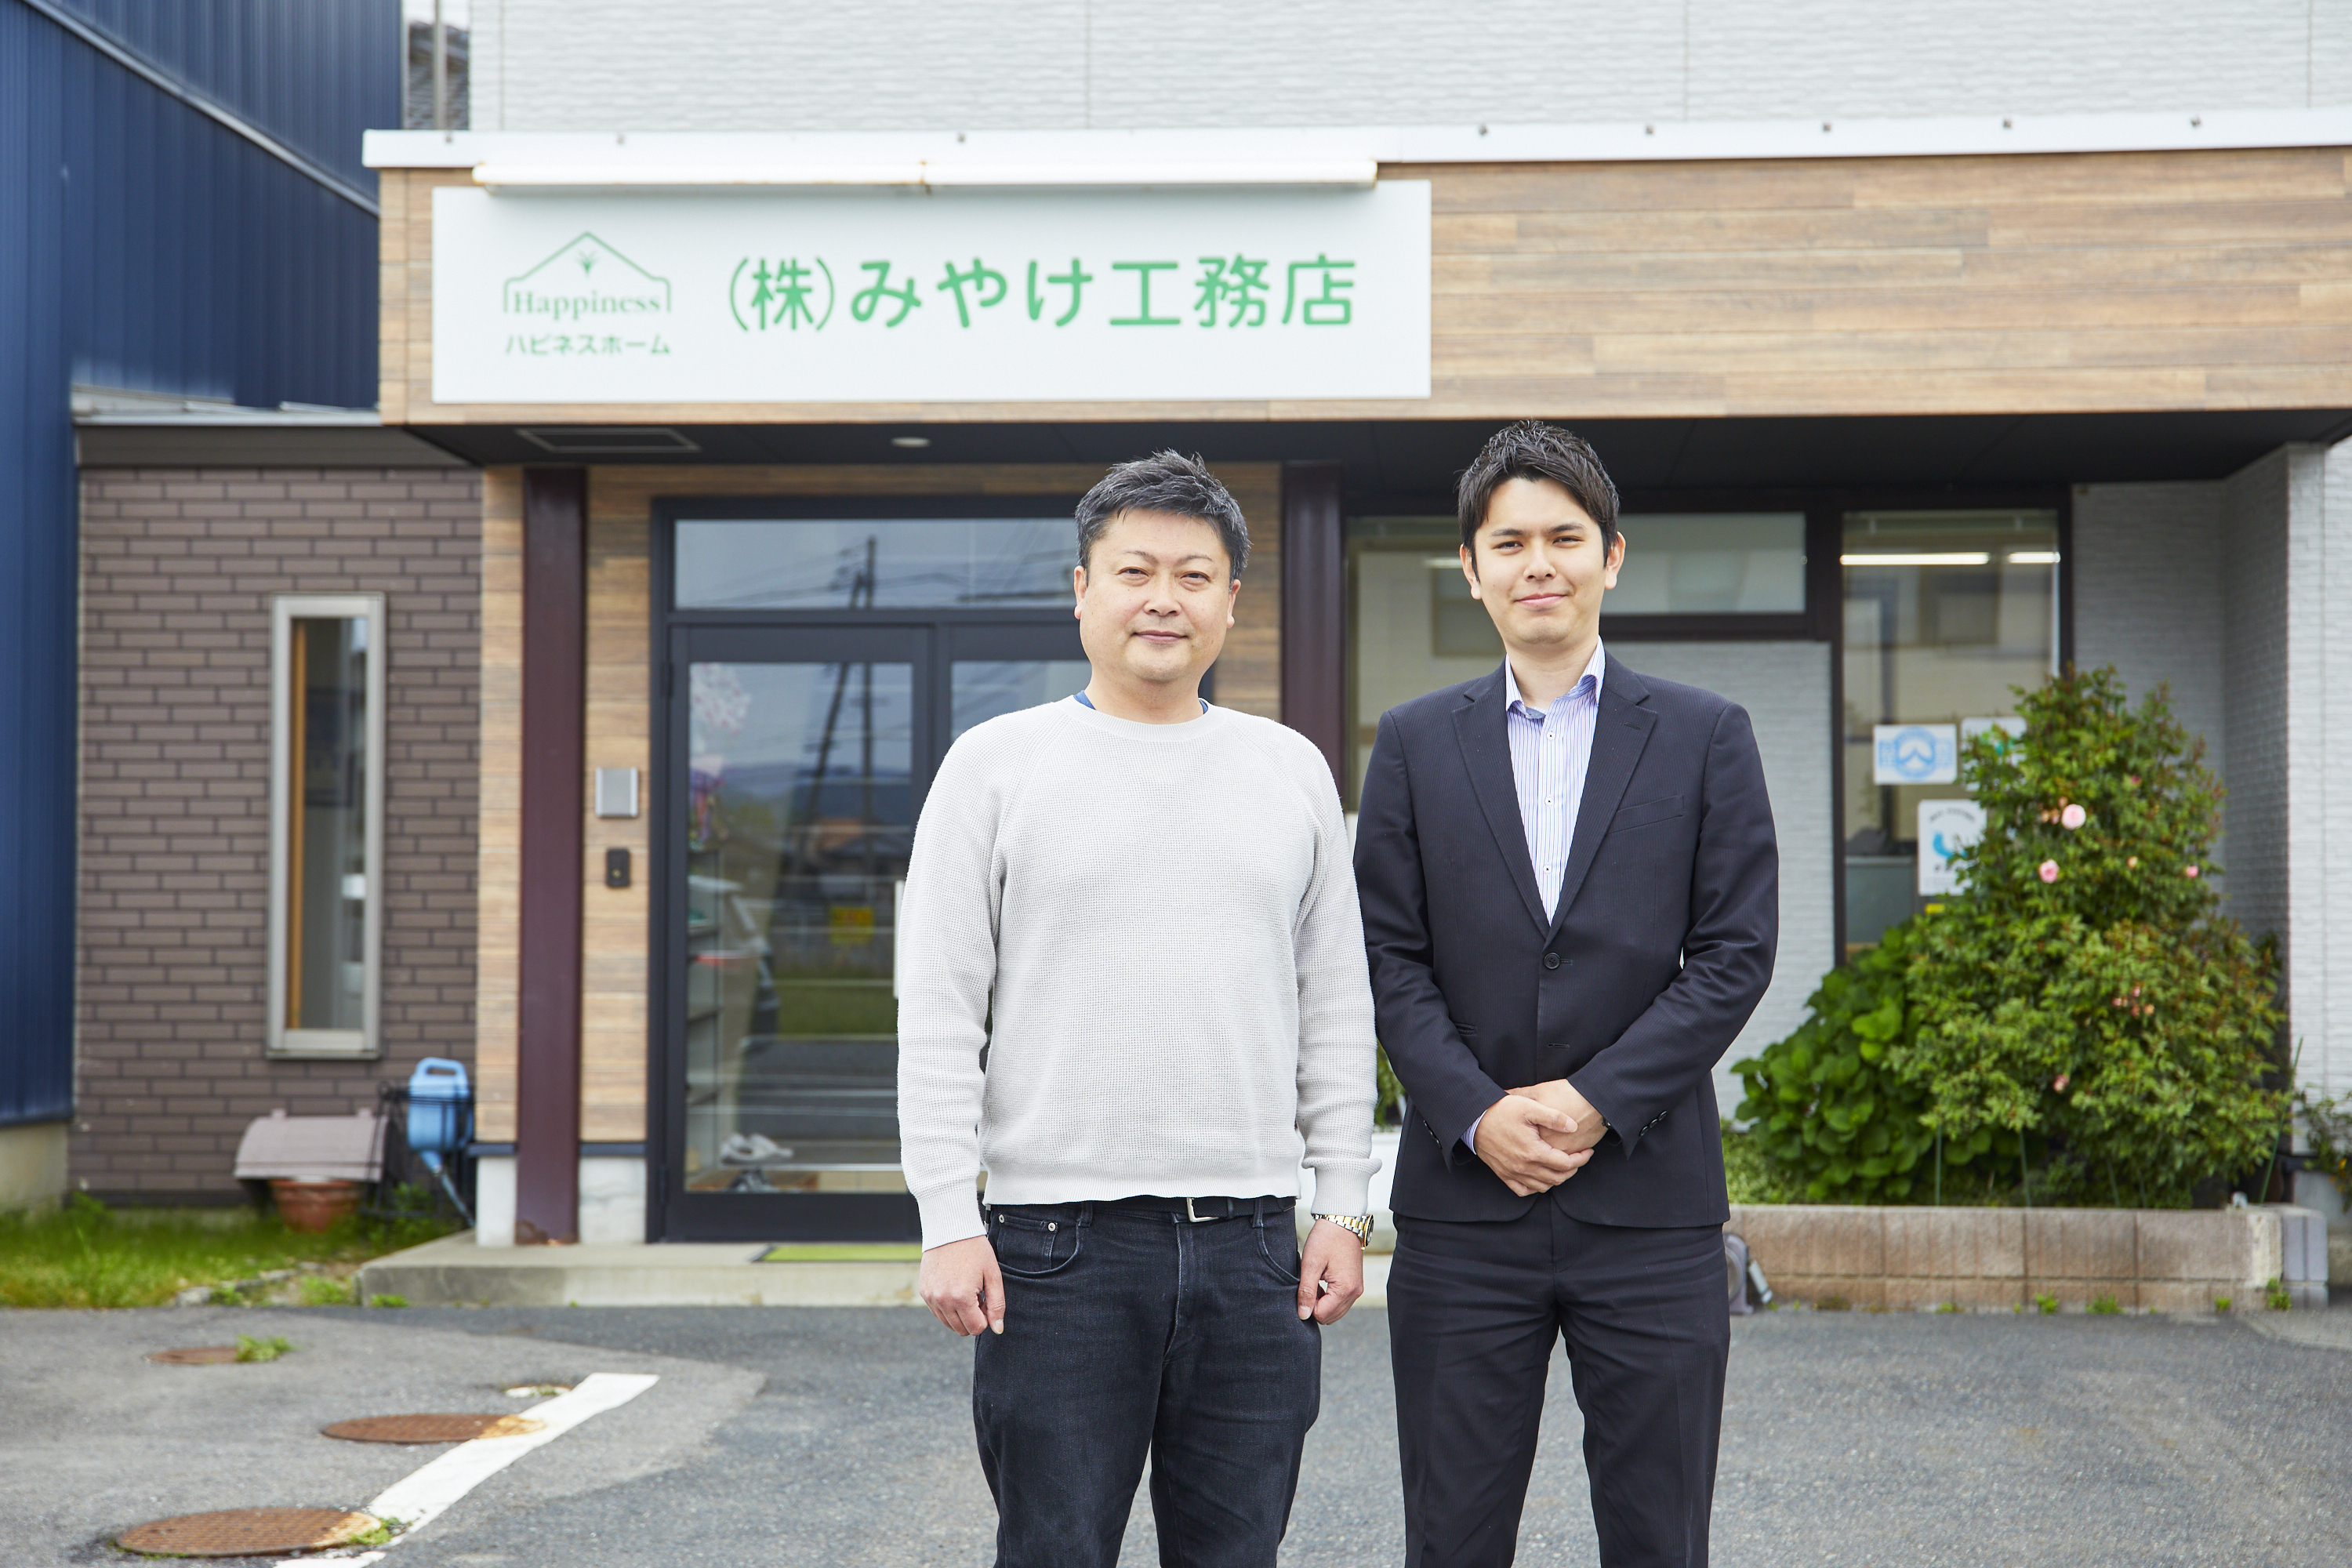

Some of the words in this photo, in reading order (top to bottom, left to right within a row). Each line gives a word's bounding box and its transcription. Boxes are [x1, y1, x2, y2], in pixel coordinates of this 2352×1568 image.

[514, 291, 660, 321] Happiness
[730, 253, 1356, 332] (株)みやけ工務店
